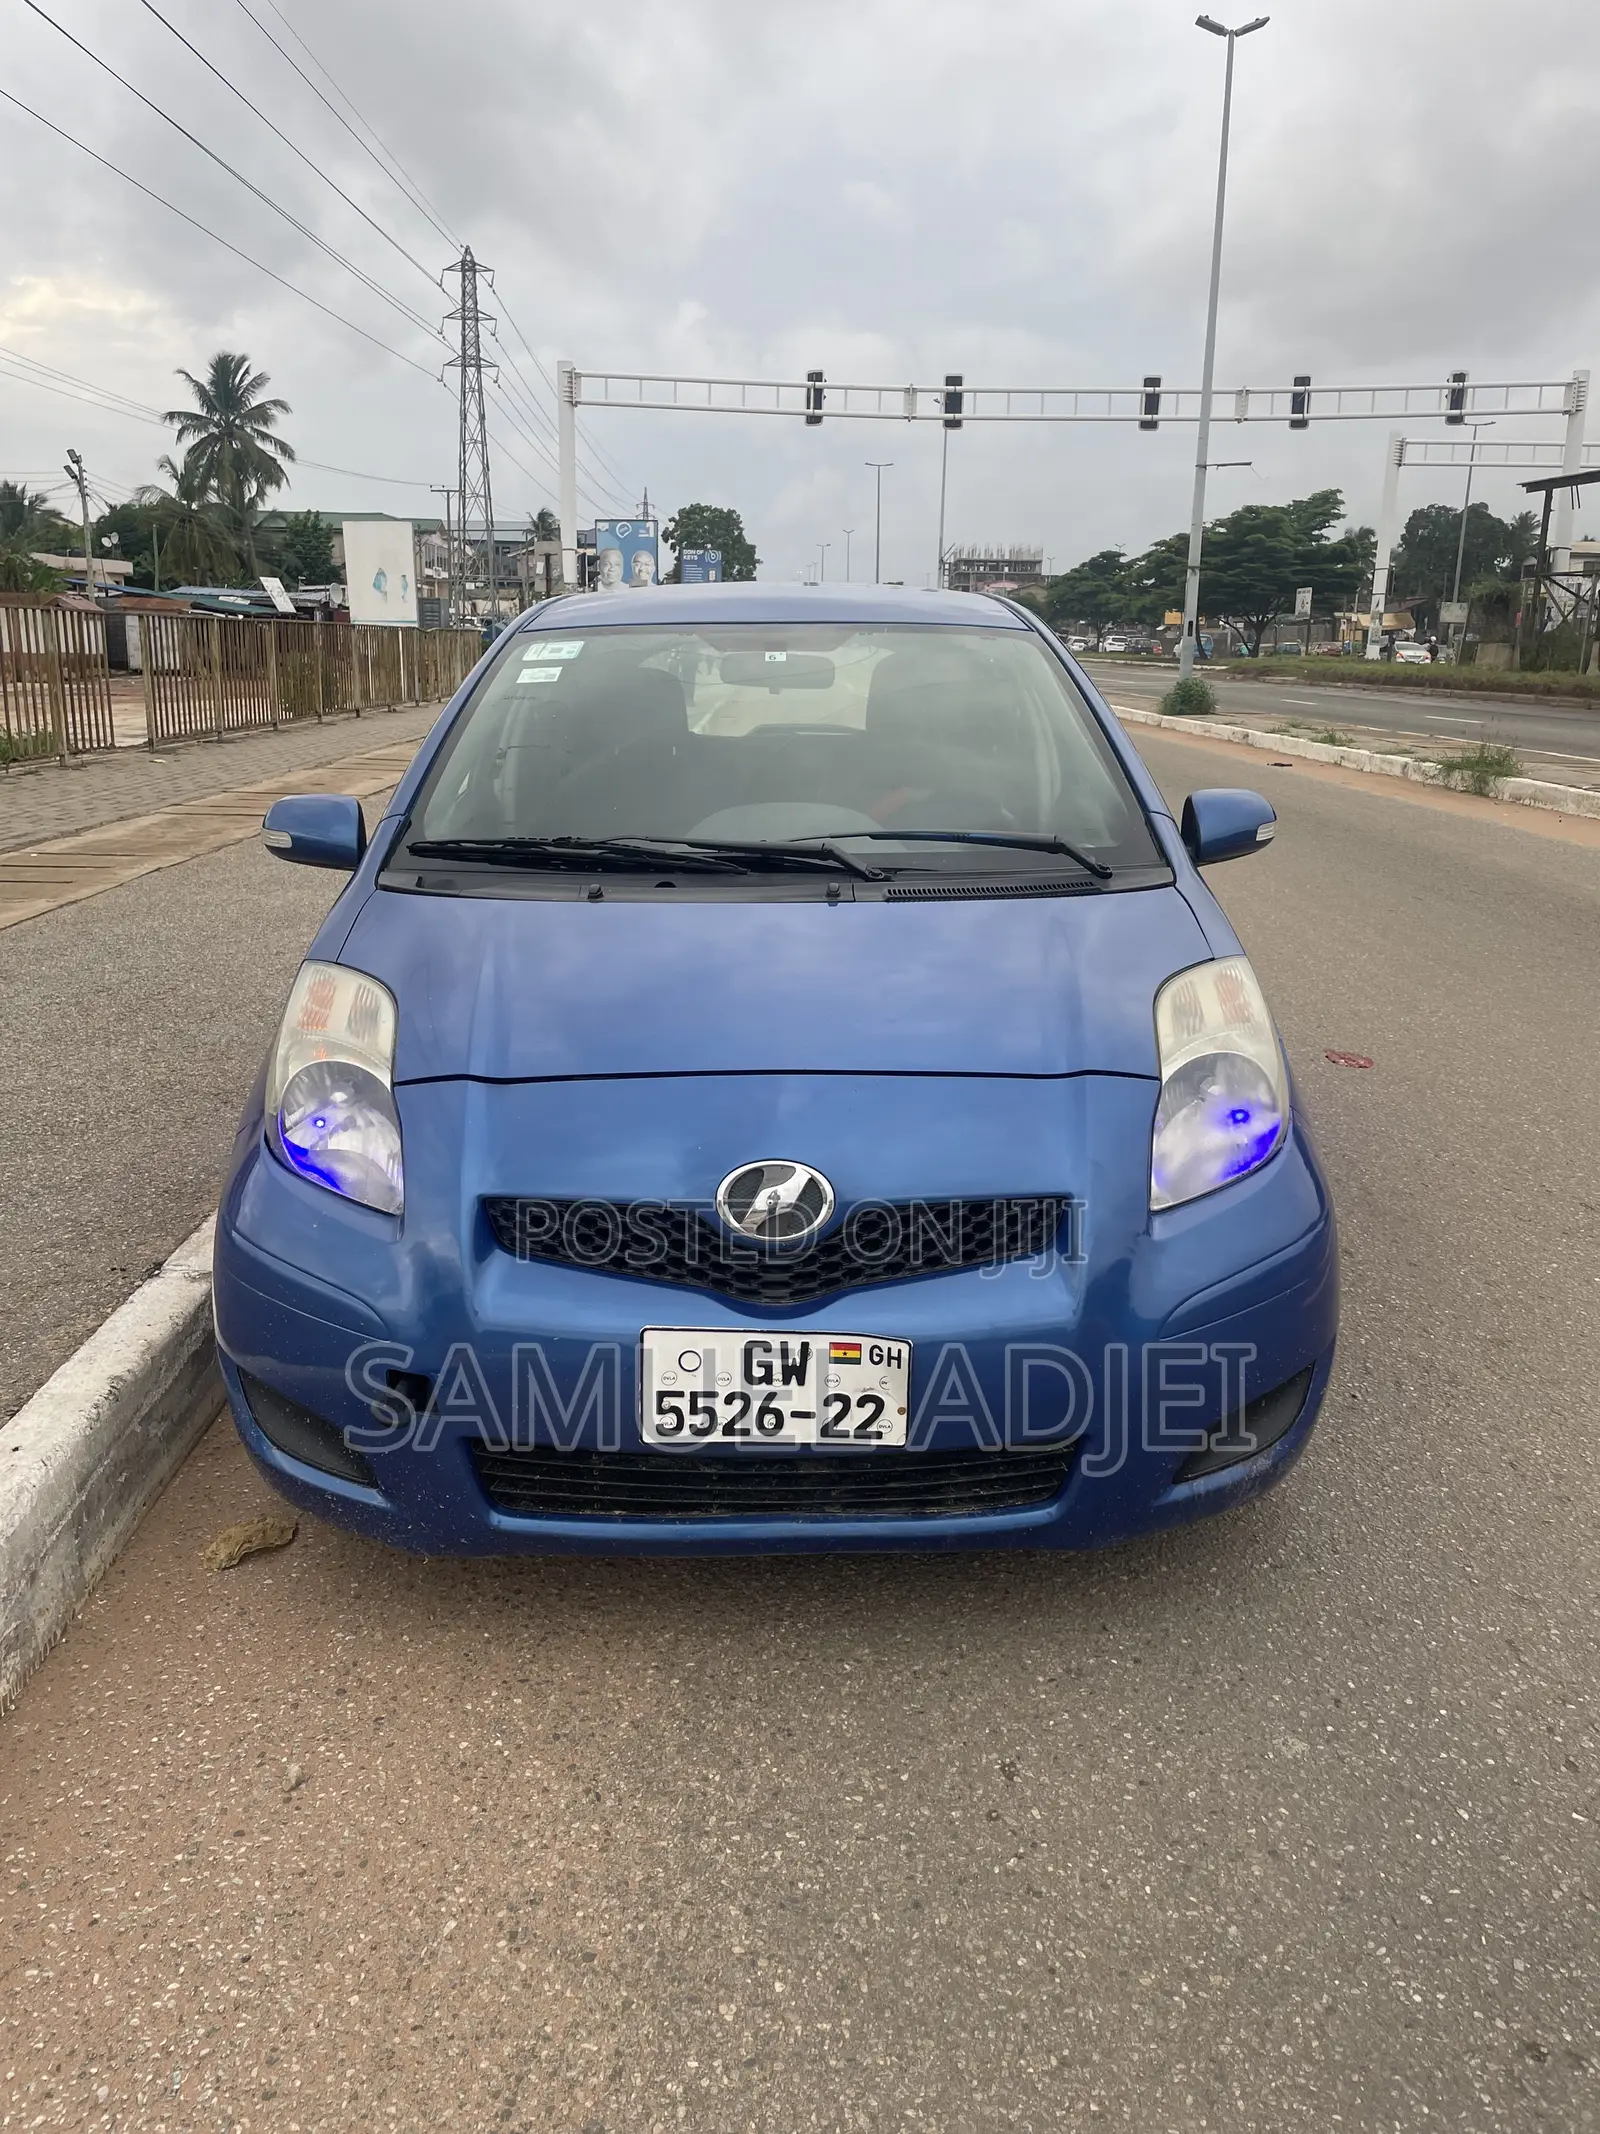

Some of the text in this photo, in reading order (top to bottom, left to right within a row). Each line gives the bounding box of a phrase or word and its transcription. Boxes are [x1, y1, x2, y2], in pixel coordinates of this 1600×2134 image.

[744, 1340, 810, 1387] GW
[869, 1344, 902, 1370] GH
[656, 1390, 884, 1440] 5526-22
